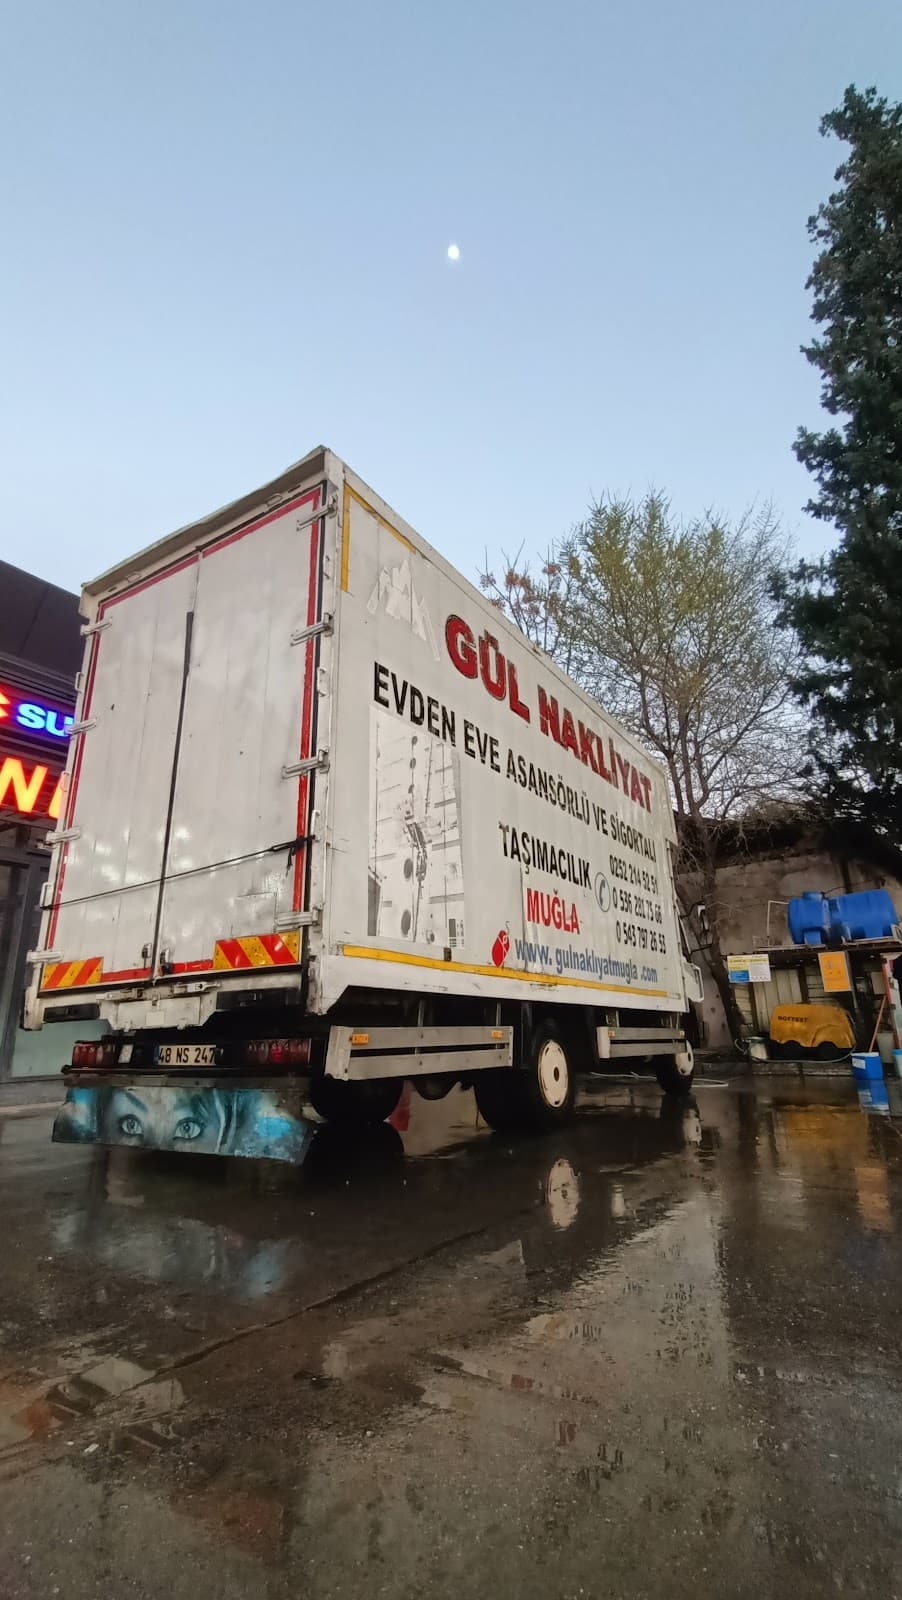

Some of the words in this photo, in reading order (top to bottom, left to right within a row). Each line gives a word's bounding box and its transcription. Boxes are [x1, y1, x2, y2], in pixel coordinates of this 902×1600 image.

[445, 614, 530, 723] GÜL
[537, 685, 652, 814] NAKLİYAT
[373, 661, 456, 747] EVDEN
[463, 719, 500, 773] EVE
[506, 748, 590, 826] ASANSÖRLÜ
[592, 802, 608, 836] VE
[610, 811, 656, 864] SİGORTALI
[498, 820, 592, 890] TAŞIMACILIK
[609, 854, 628, 882] 0252
[642, 870, 651, 892] 52
[526, 887, 580, 935] MUĞLA
[612, 886, 618, 909] 0
[619, 888, 632, 914] 536
[616, 919, 621, 943] 0
[623, 921, 637, 947] 543
[158, 1047, 172, 1064] 48
[175, 1047, 189, 1064] NS
[194, 1047, 216, 1064] 247
